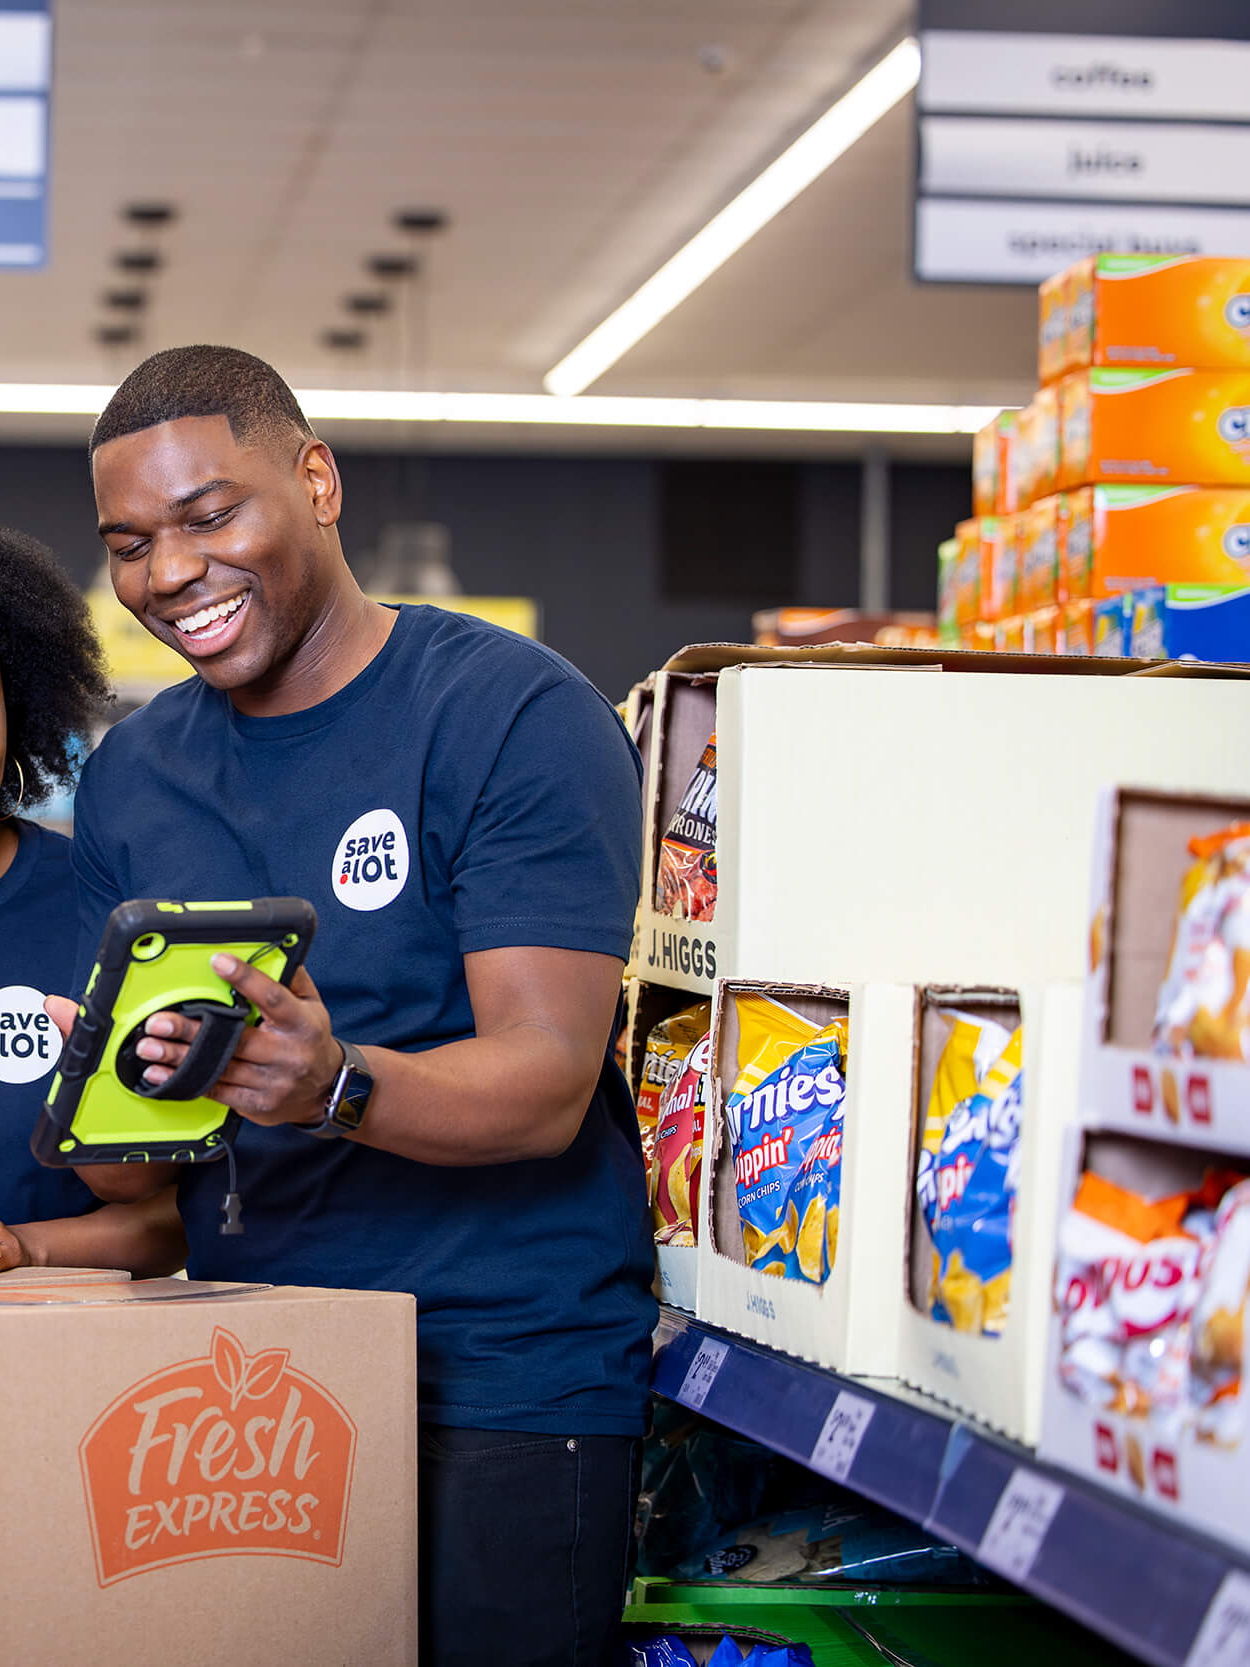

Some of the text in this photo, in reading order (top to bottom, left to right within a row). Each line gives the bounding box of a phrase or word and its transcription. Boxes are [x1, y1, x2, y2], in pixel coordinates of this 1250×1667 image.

[1052, 62, 1153, 90] coffee
[1068, 146, 1144, 176] juice
[1007, 231, 1114, 256] special
[344, 830, 396, 858] save
[341, 860, 351, 875] a
[738, 1180, 781, 1209] CORN CHIPS
[128, 1385, 321, 1496] Fresh
[124, 1489, 321, 1551] EXPRESS
